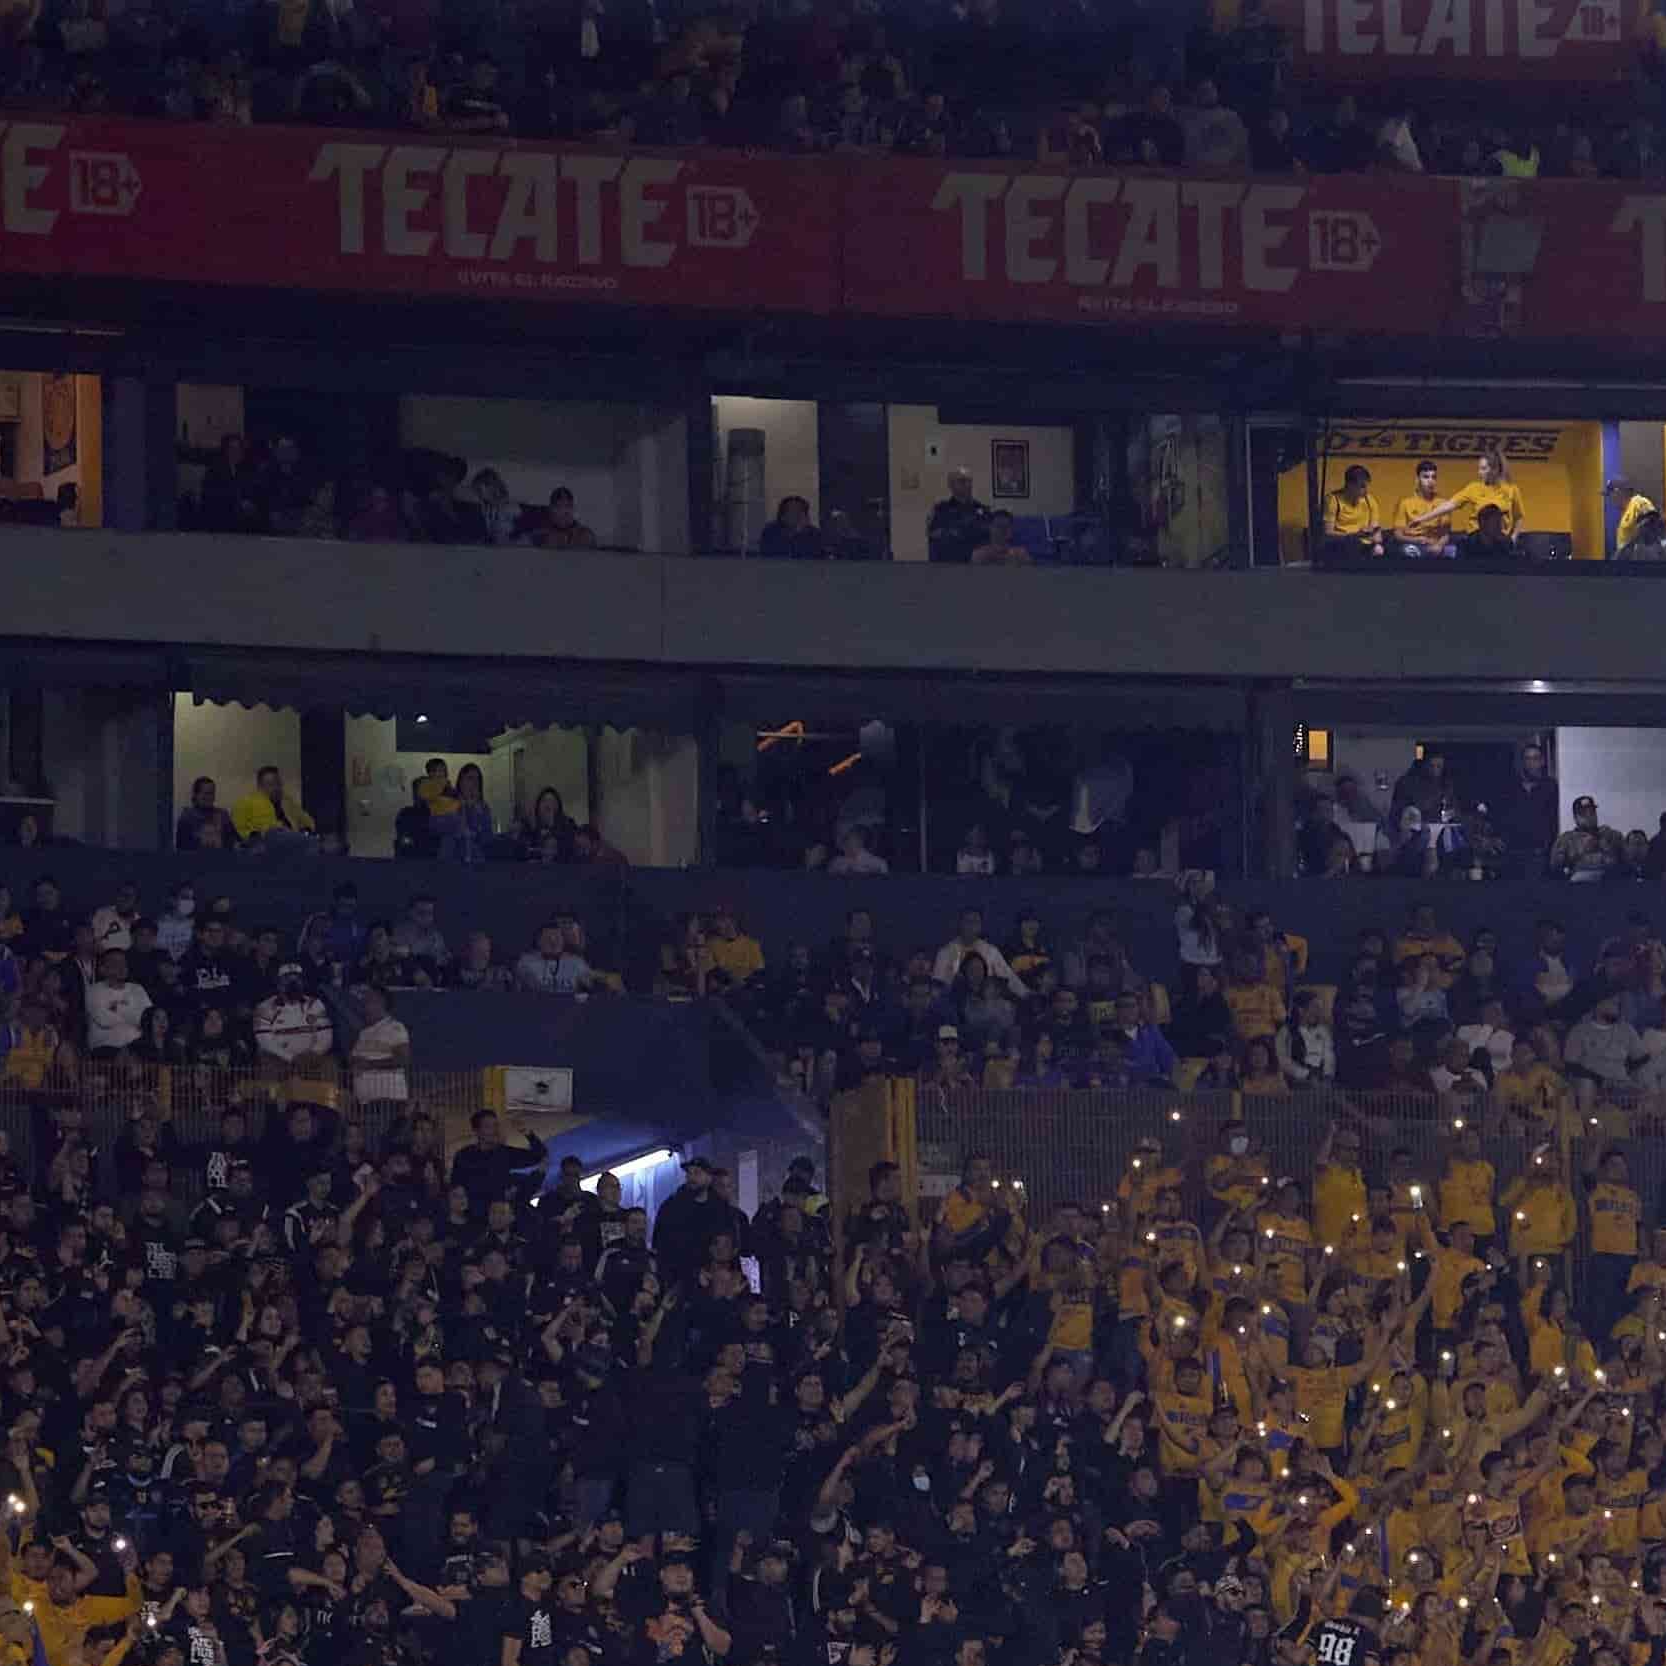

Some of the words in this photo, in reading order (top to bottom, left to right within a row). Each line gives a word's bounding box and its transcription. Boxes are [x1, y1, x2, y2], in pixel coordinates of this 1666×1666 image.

[308, 143, 684, 268] TECATE
[931, 171, 1306, 292] TECATE
[1405, 432, 1557, 451] TIGRES
[1319, 1632, 1355, 1666] 98
